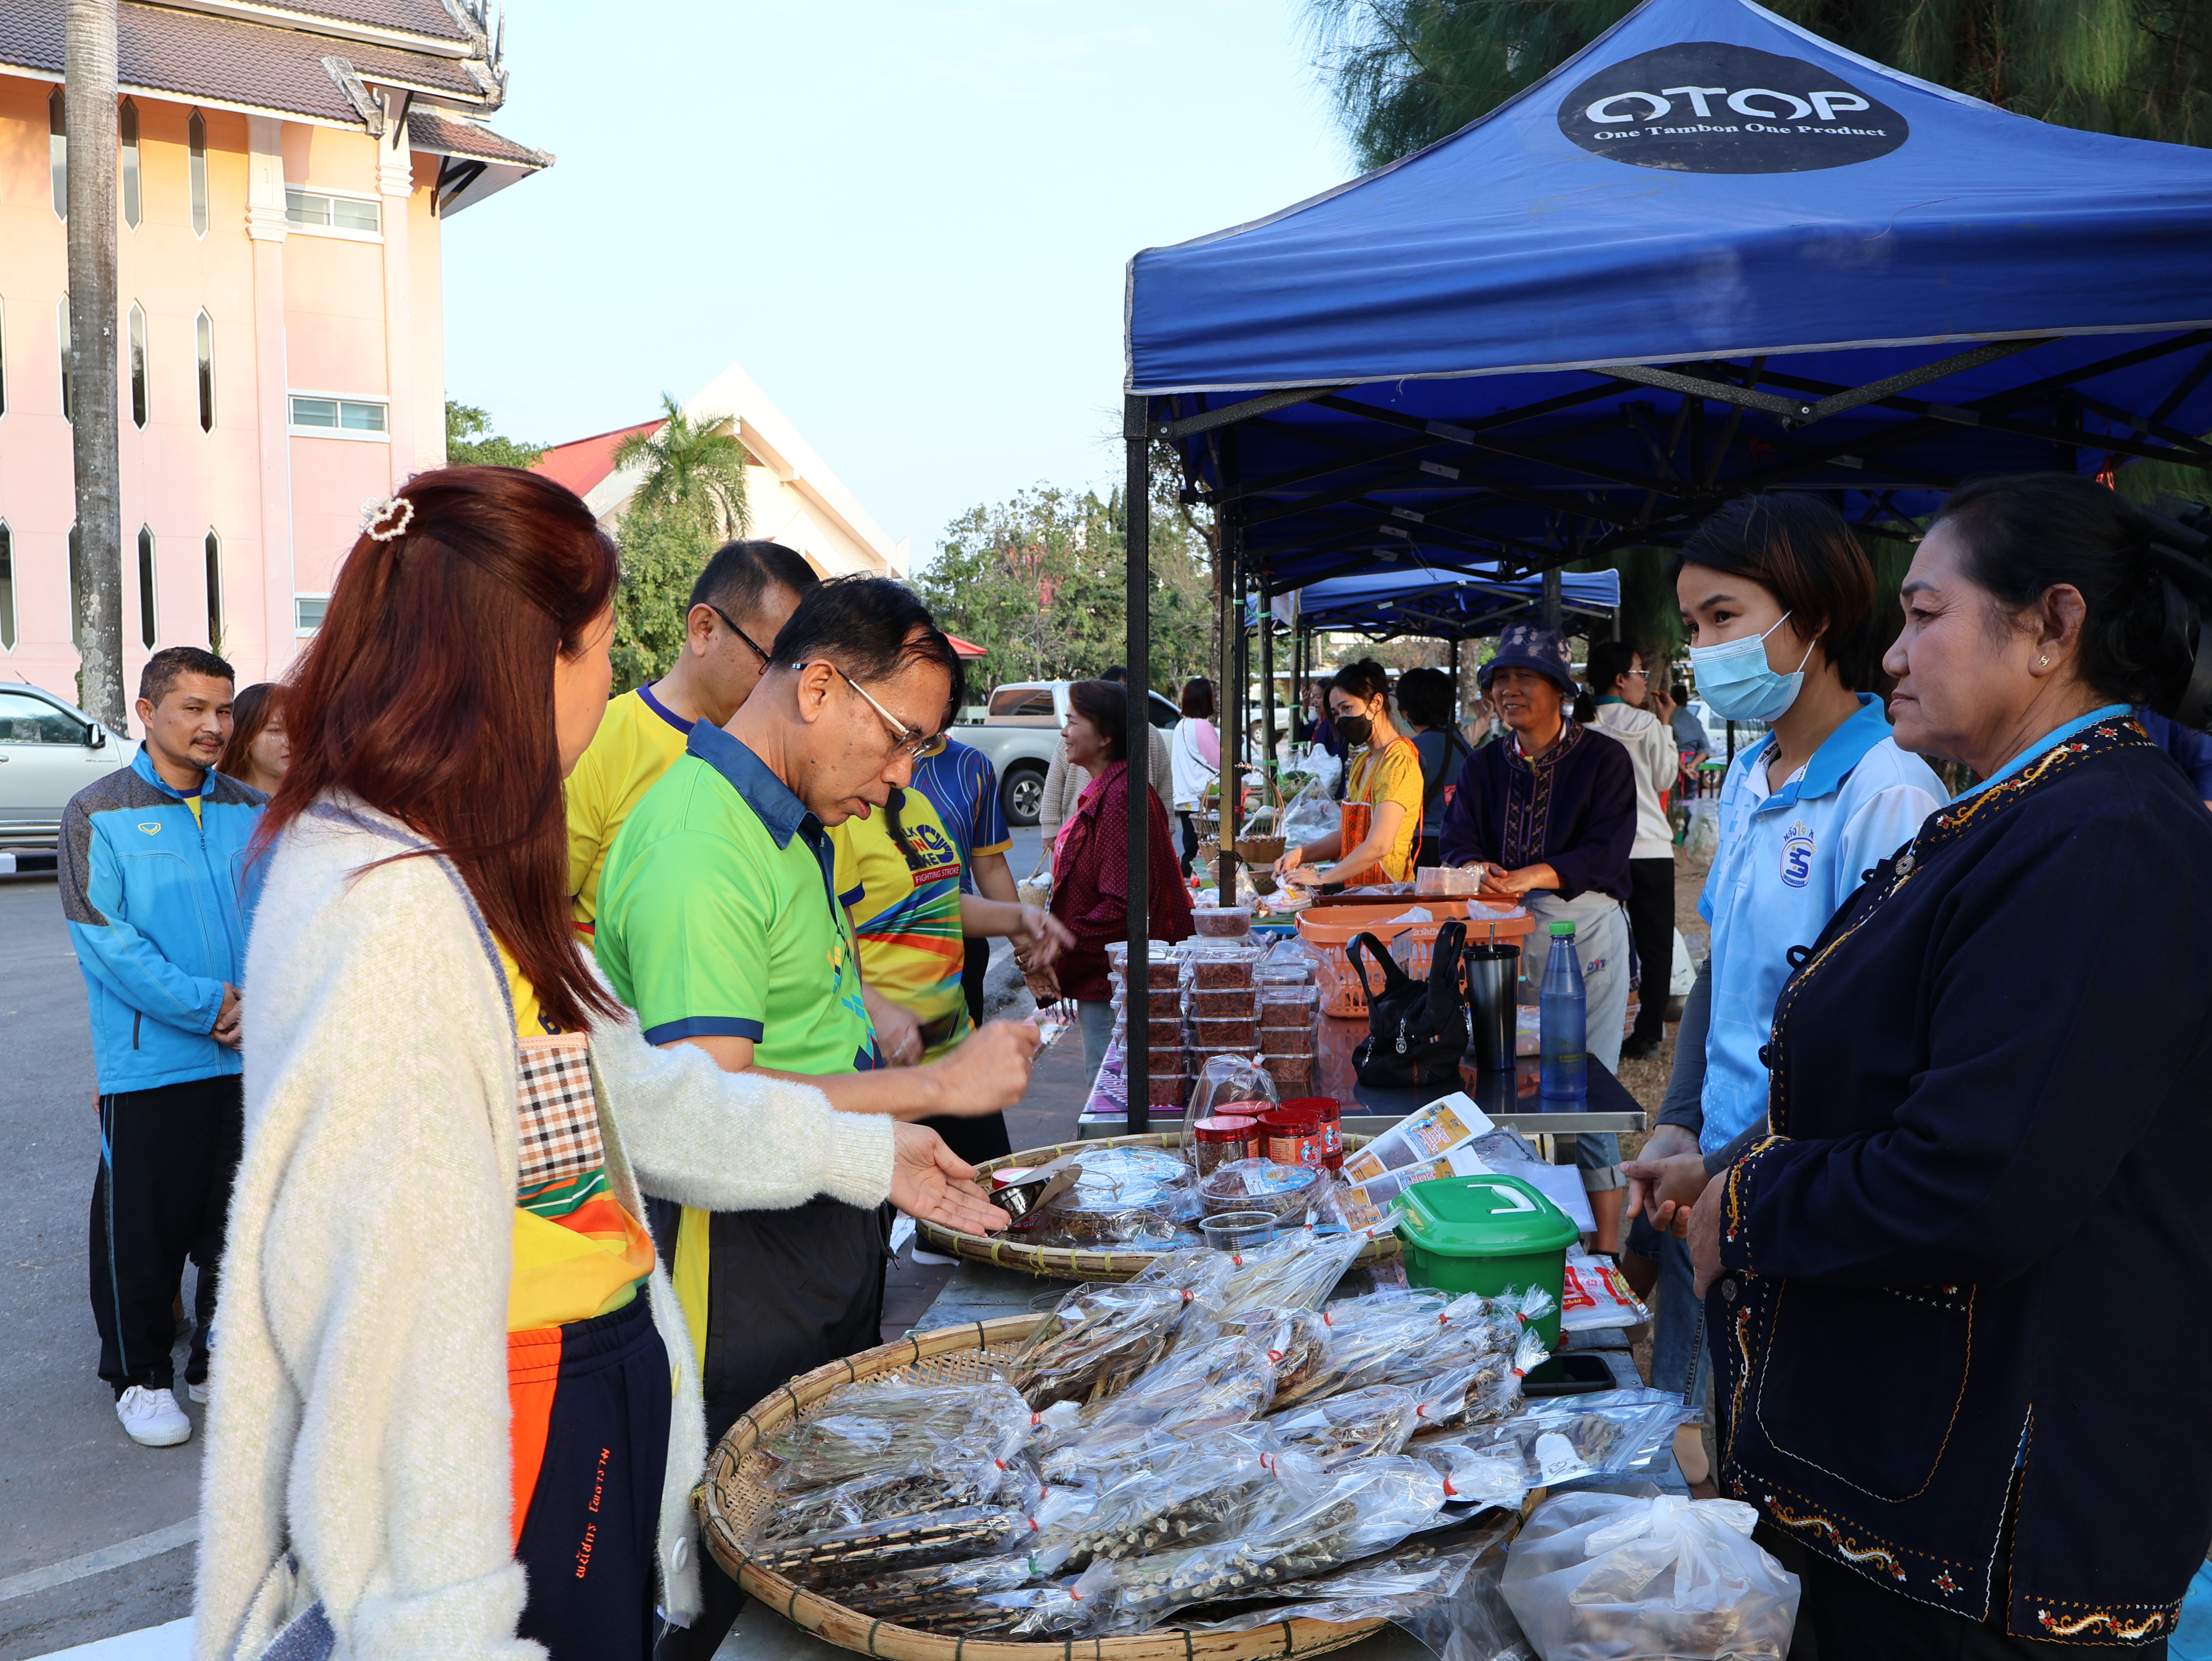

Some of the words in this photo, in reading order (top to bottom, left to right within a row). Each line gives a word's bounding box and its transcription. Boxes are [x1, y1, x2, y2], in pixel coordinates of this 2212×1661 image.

[1586, 86, 1870, 123] OTOP
[1594, 129, 1640, 140] One
[1645, 124, 1740, 136] Tambon
[1745, 123, 1791, 134] One
[1797, 126, 1887, 137] Product
[915, 871, 941, 884] FIGHTING
[942, 867, 959, 877] STROKE
